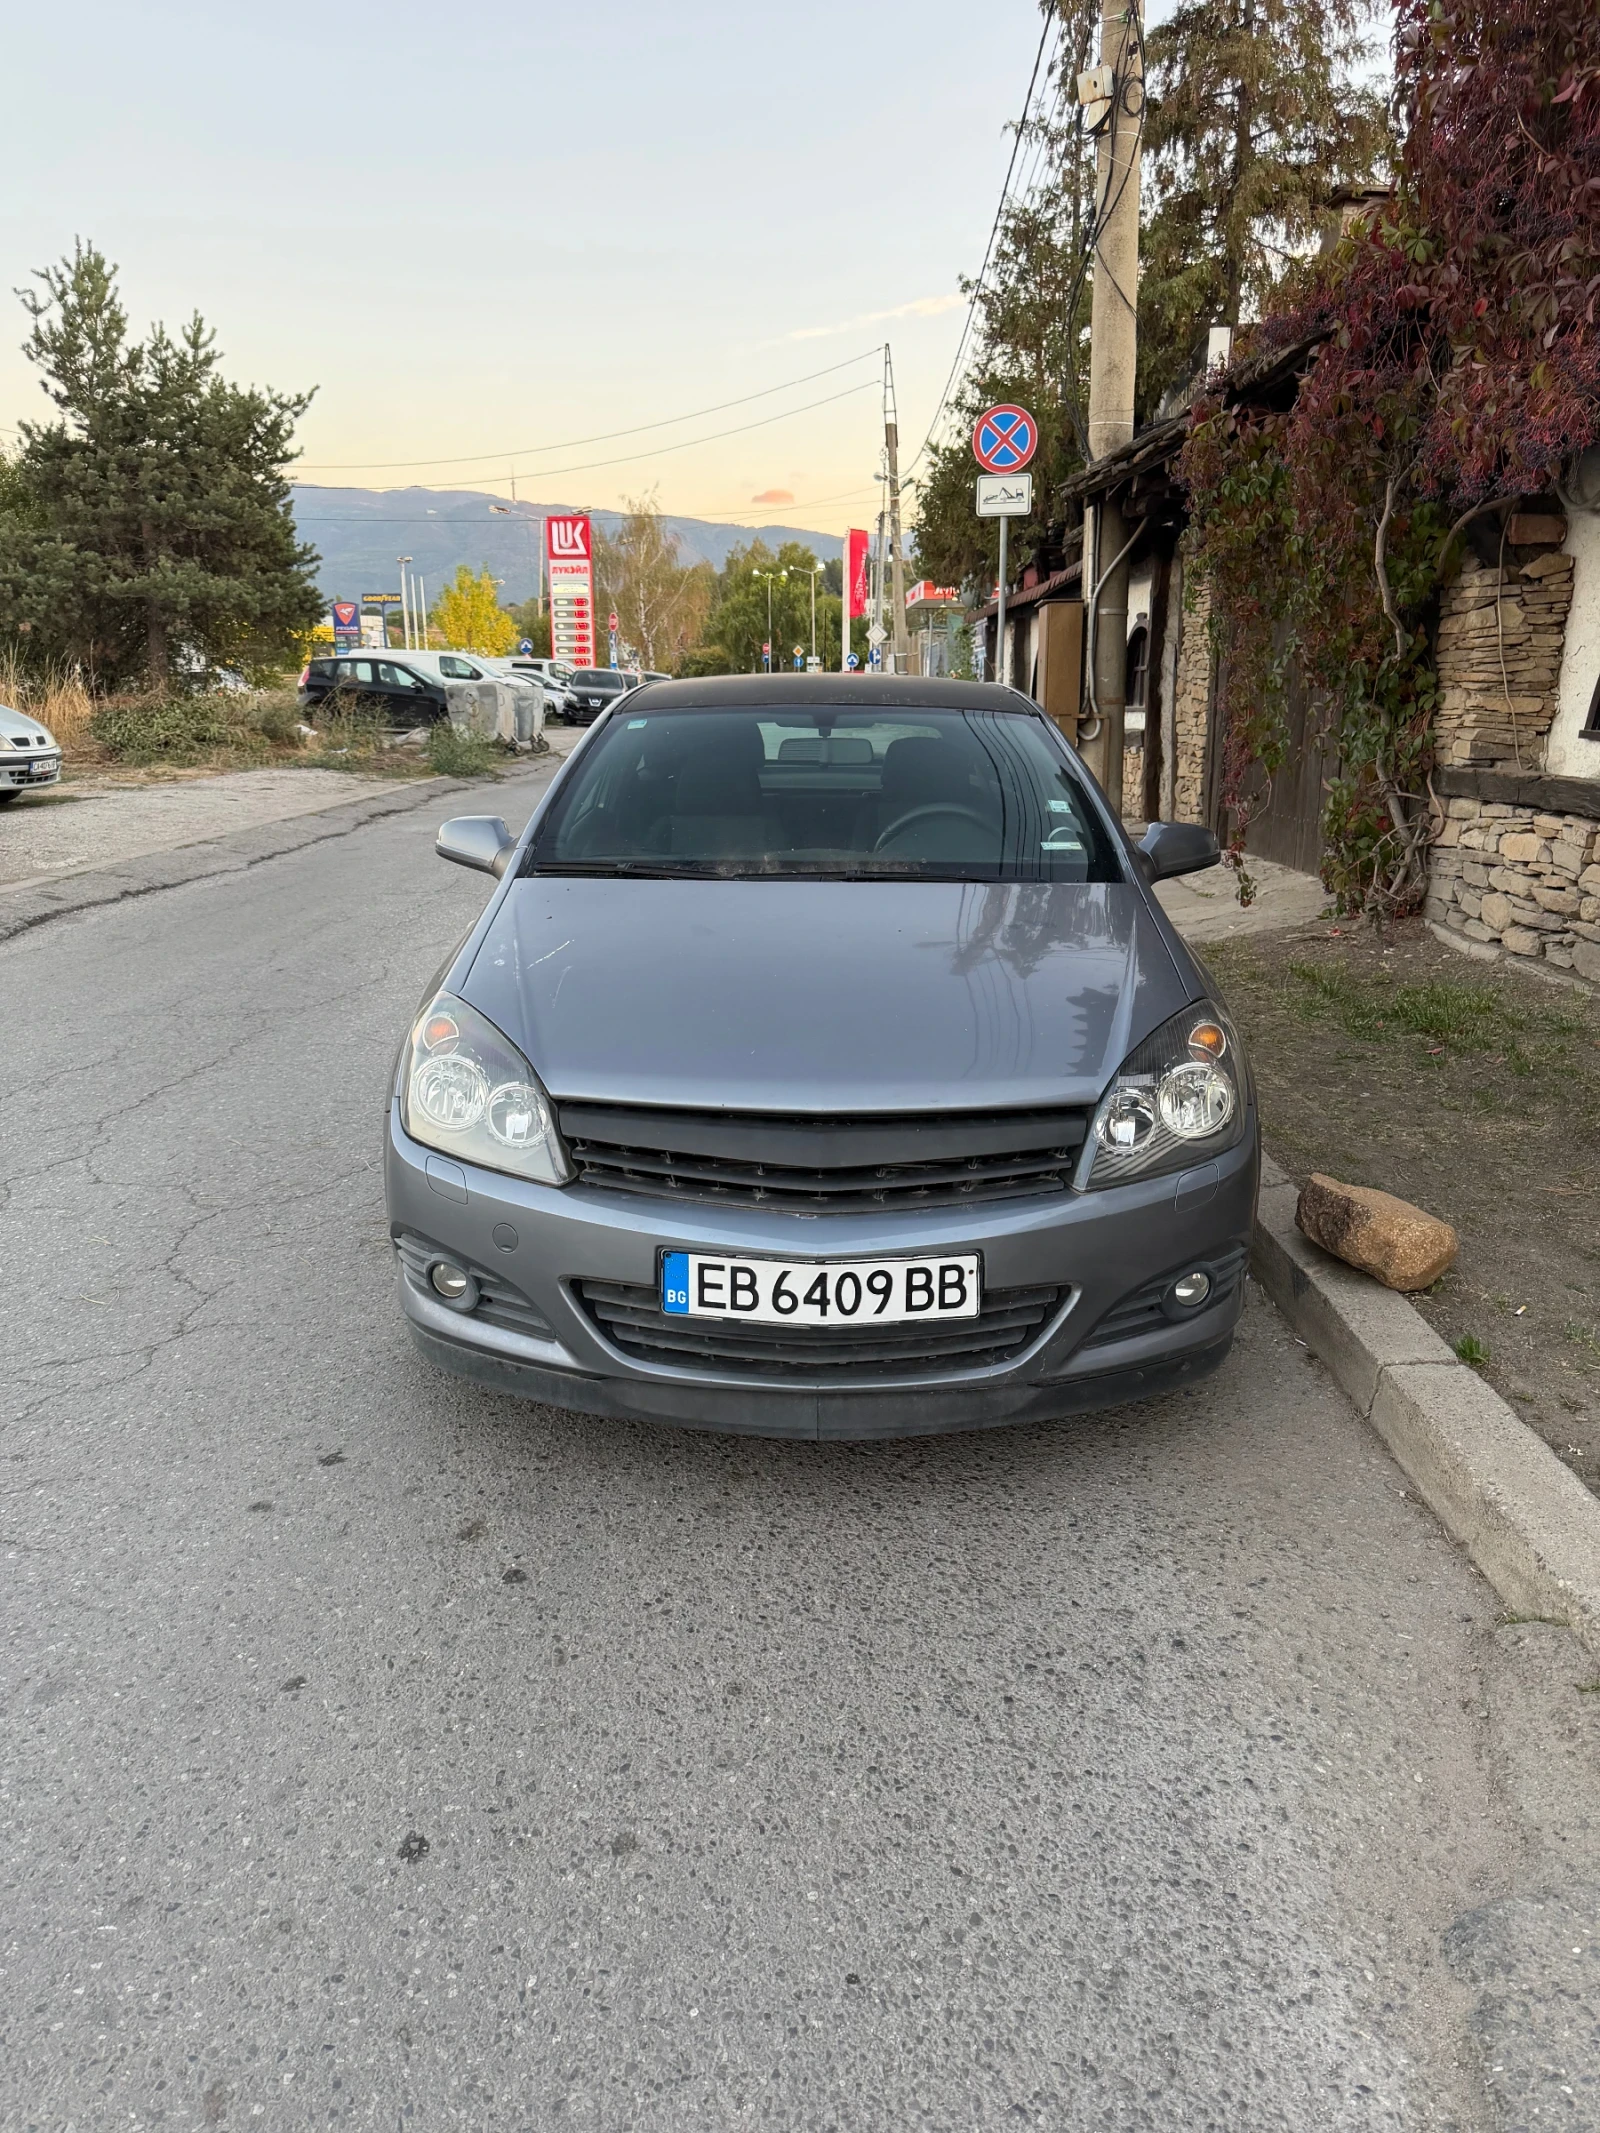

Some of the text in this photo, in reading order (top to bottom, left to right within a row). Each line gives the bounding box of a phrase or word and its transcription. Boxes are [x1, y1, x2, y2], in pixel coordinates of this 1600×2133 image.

[363, 594, 401, 602] GOODYEAR
[697, 1262, 968, 1317] EB 6409 BB
[667, 1290, 687, 1304] BG
